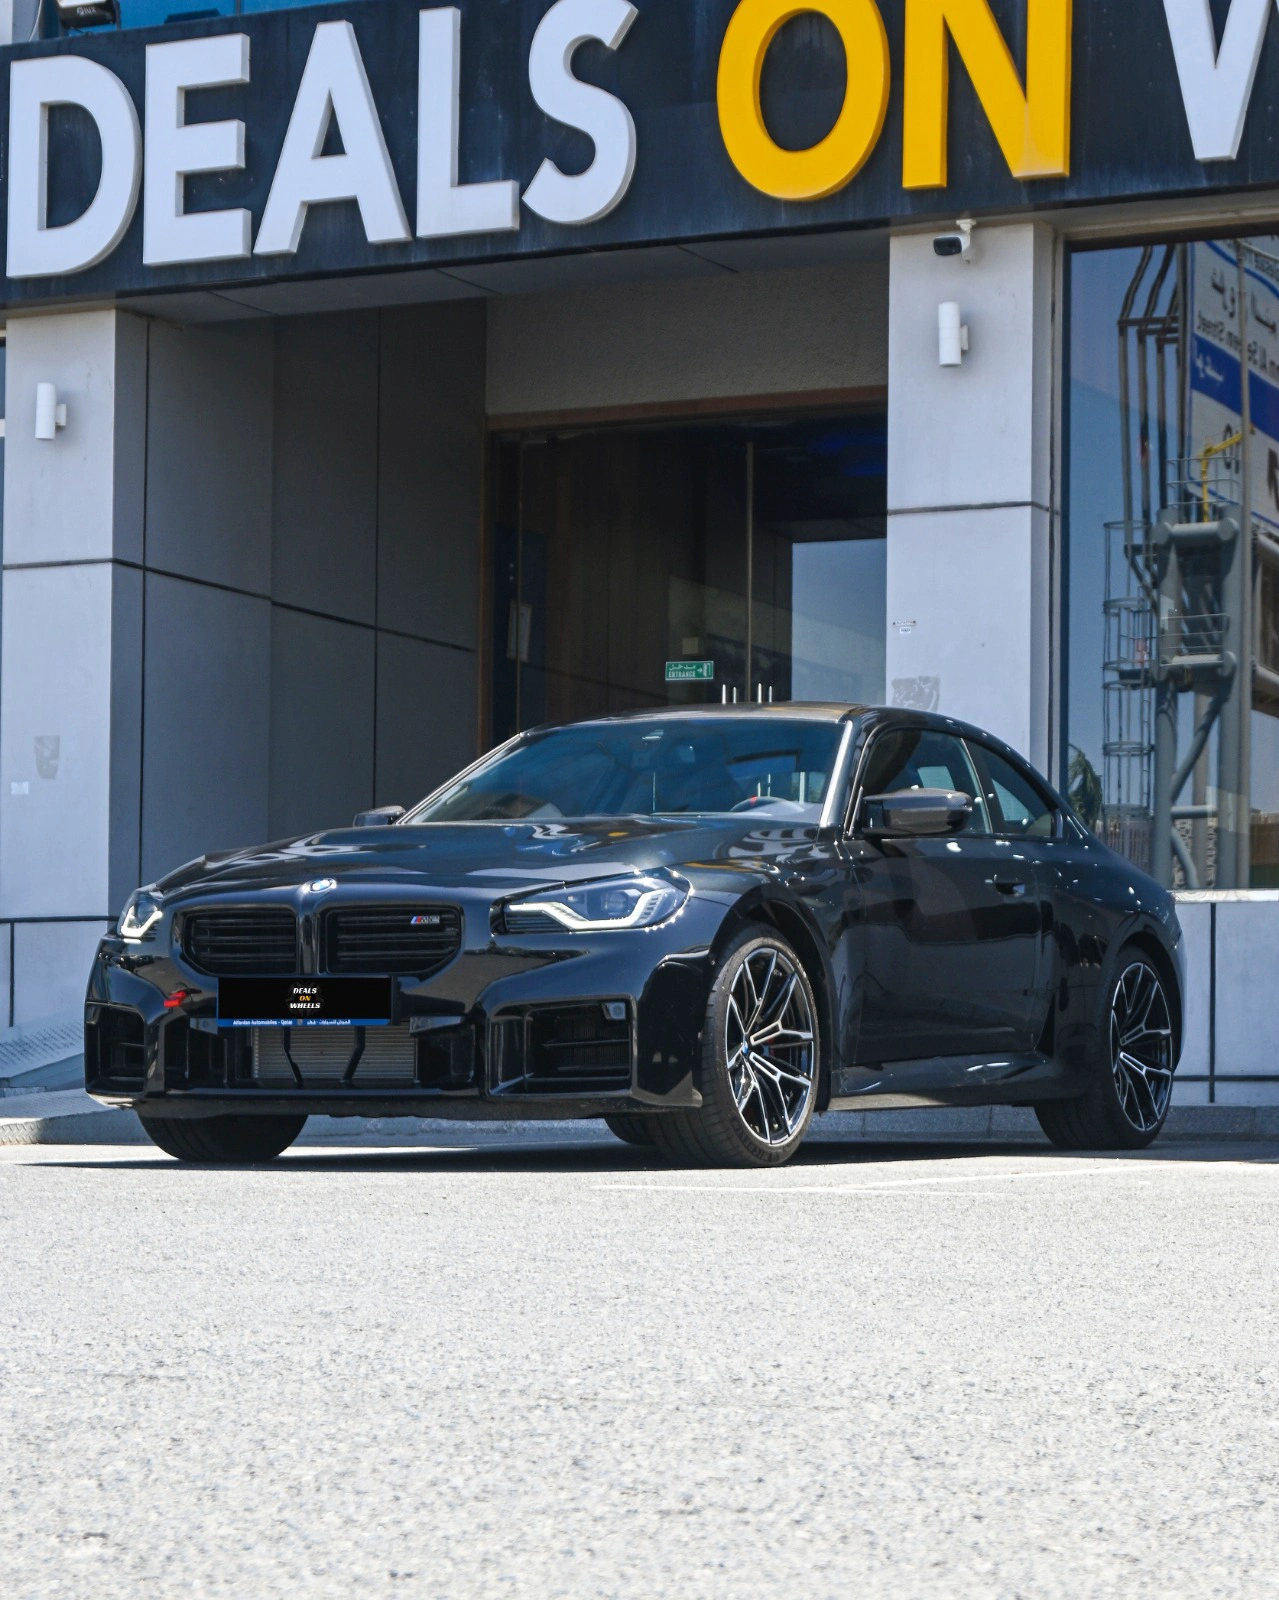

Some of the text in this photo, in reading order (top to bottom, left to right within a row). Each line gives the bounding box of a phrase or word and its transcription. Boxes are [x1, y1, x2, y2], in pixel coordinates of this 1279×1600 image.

[6, 0, 638, 279] DEALS
[716, 0, 1073, 201] ON
[668, 670, 696, 678] ENTRANCE
